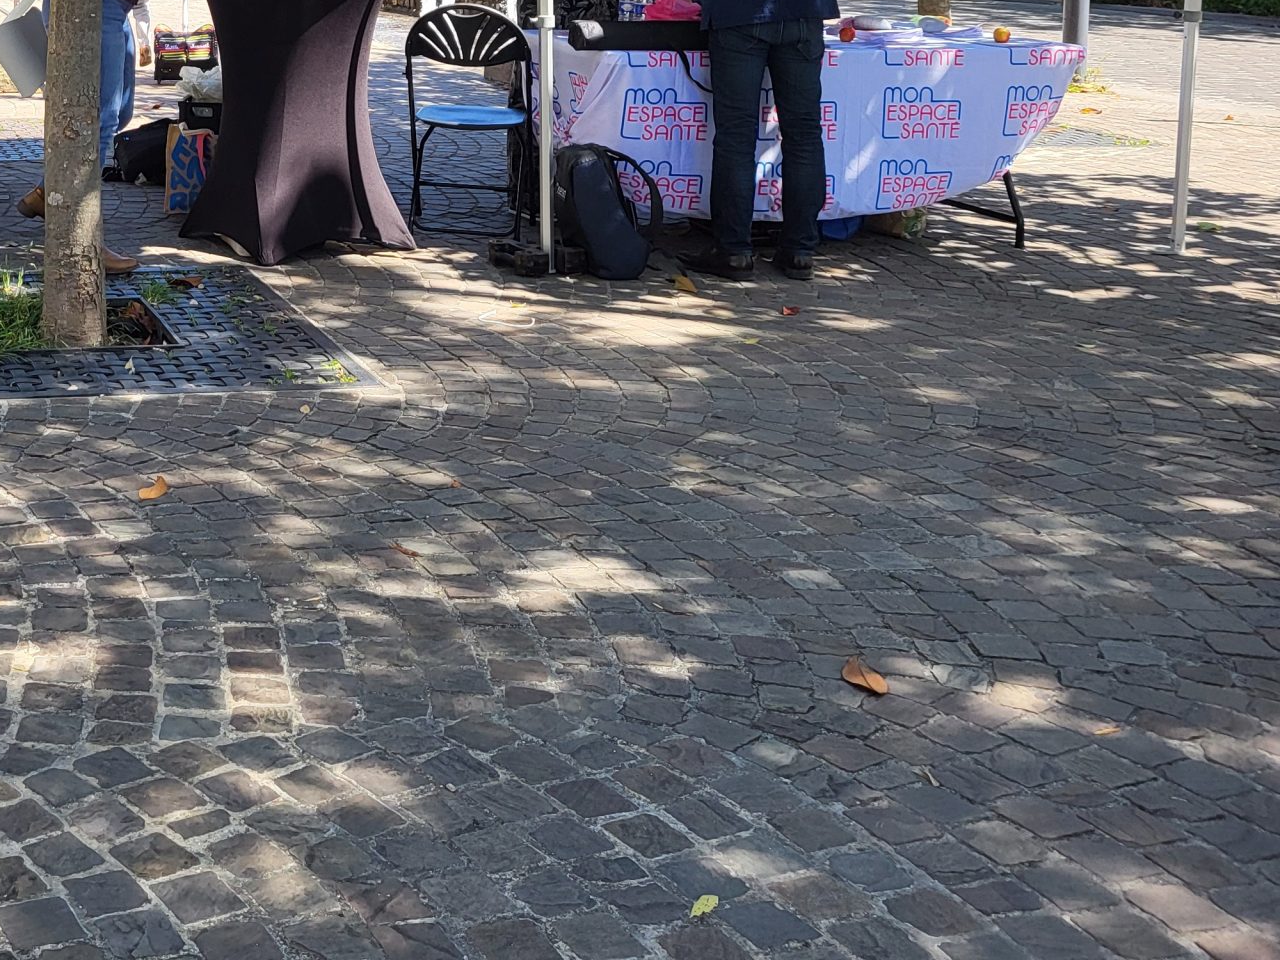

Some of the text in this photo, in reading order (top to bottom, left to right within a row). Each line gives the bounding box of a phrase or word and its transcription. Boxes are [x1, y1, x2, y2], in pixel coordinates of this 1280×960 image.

[627, 106, 704, 122] ESPACE
[887, 104, 957, 121] ESPACE
[882, 175, 948, 193] ESPACE
